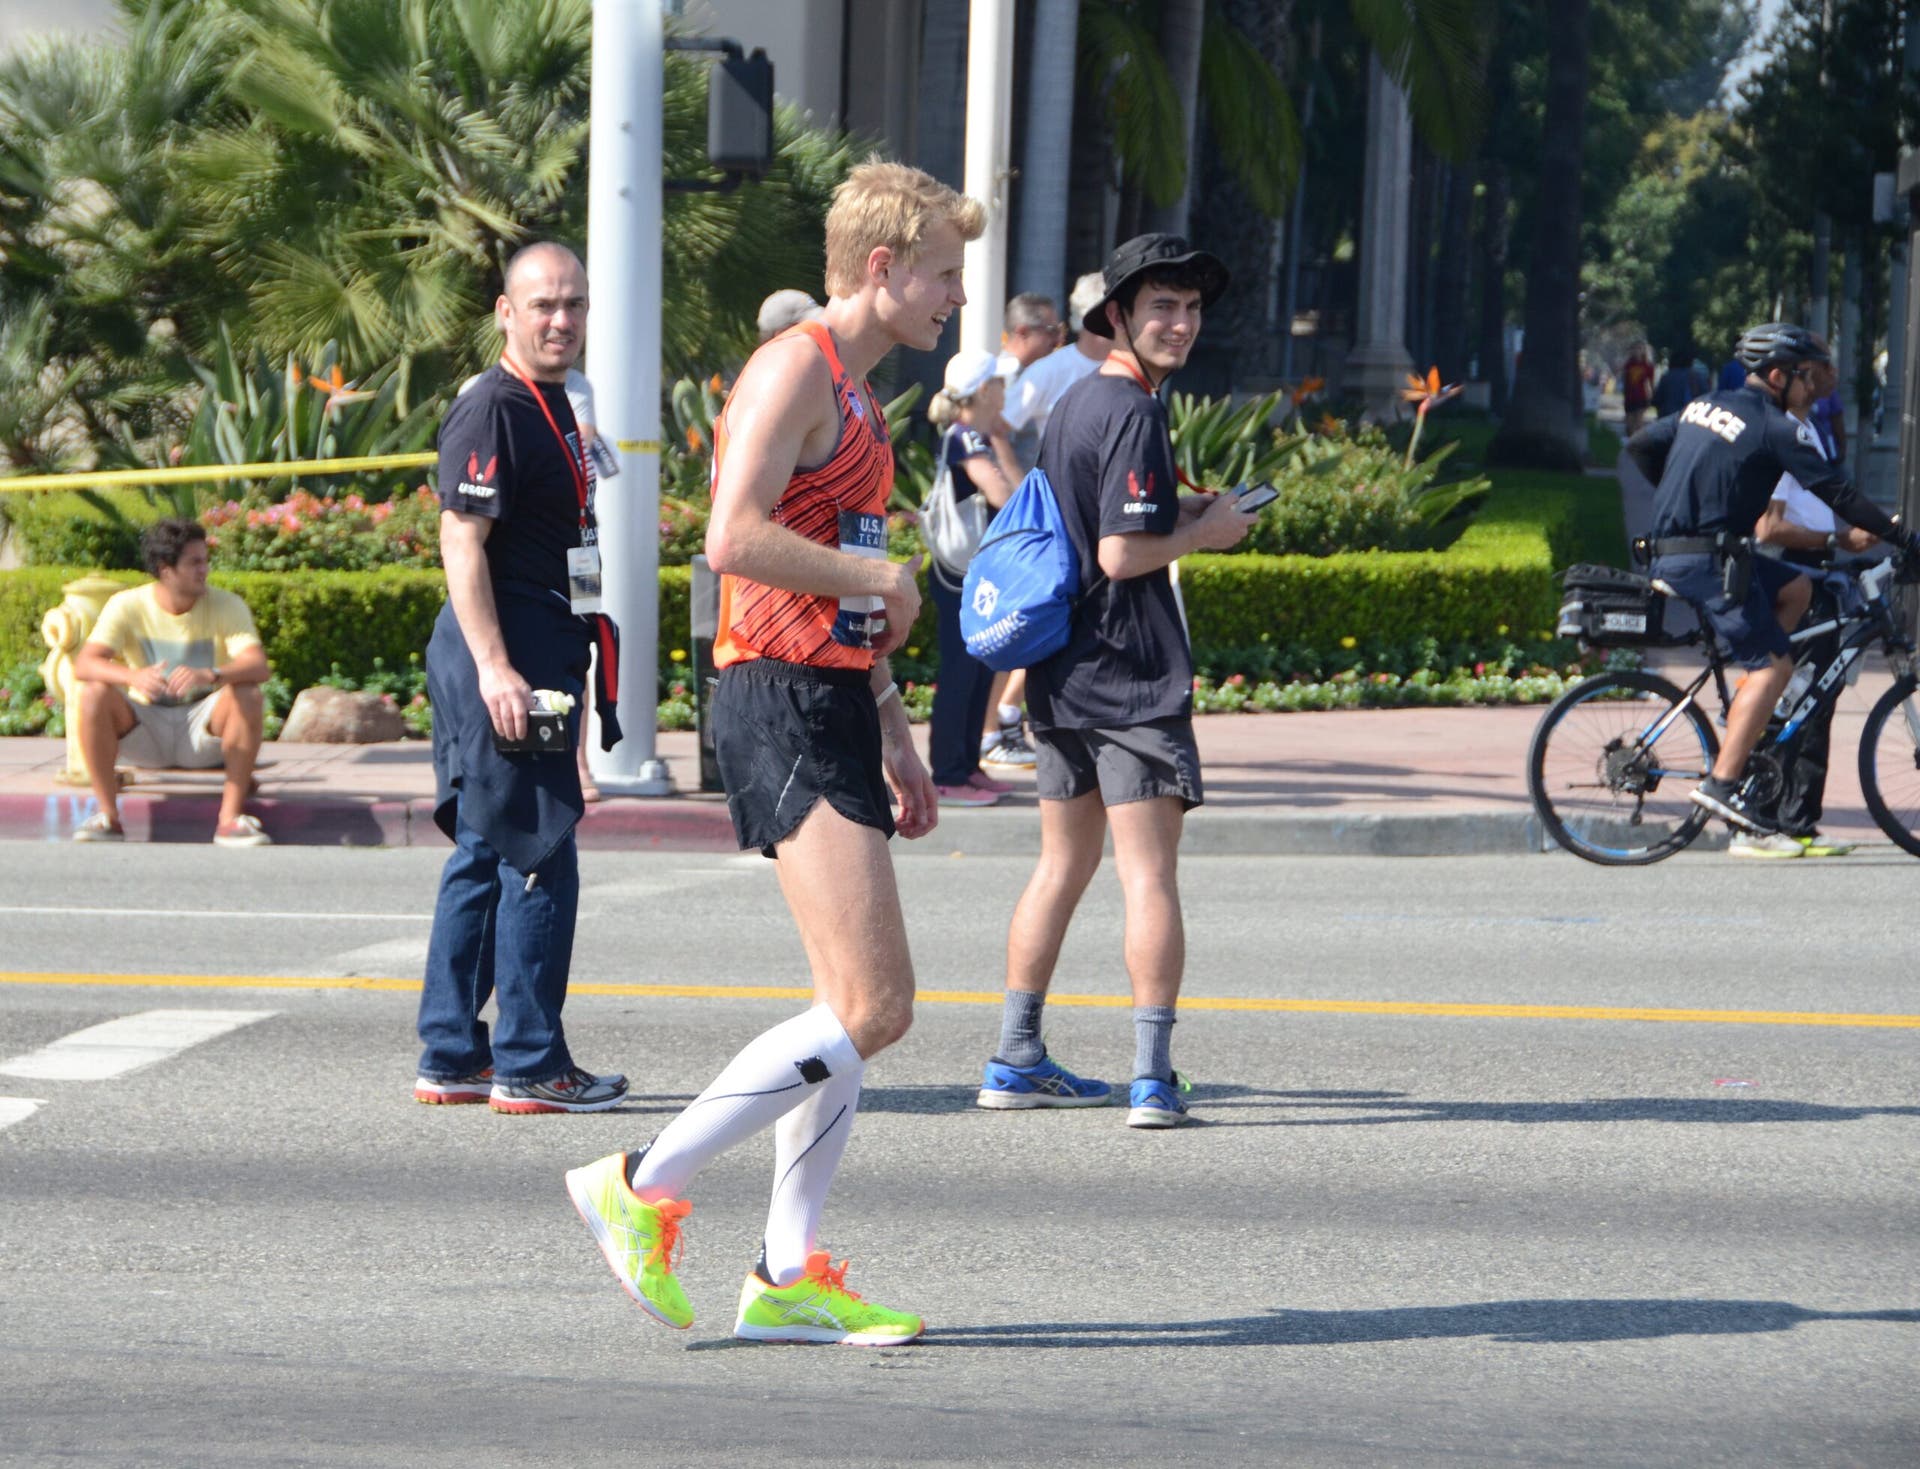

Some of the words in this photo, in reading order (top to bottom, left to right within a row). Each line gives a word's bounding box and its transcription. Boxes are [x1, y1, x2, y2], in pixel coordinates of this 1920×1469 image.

[1680, 401, 1747, 443] POLICE
[458, 482, 497, 498] USATF
[1123, 502, 1158, 514] USATF
[860, 517, 881, 534] U.S.
